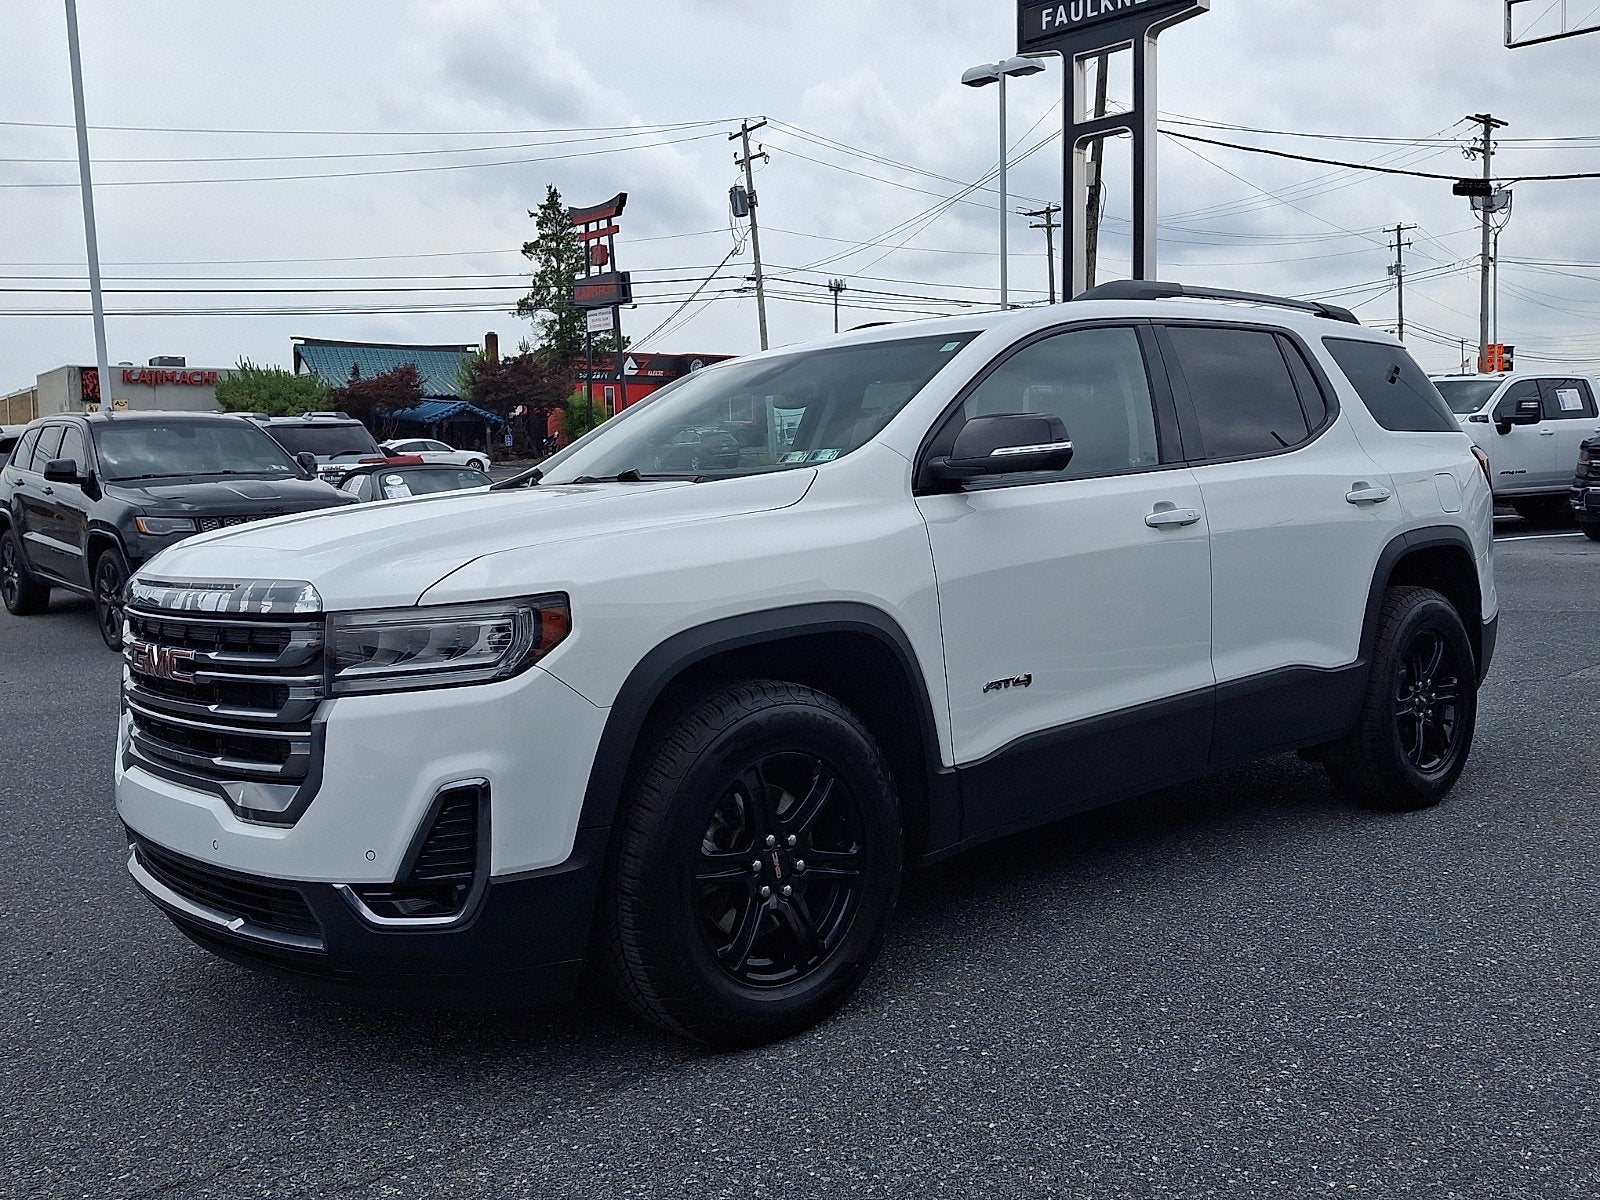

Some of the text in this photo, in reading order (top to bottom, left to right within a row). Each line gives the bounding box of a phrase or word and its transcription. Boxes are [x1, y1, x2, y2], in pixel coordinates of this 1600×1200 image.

[1041, 0, 1148, 31] FAULK
[122, 369, 217, 387] KAJIMACHI
[131, 643, 196, 684] GMC
[982, 671, 1033, 693] AT4
